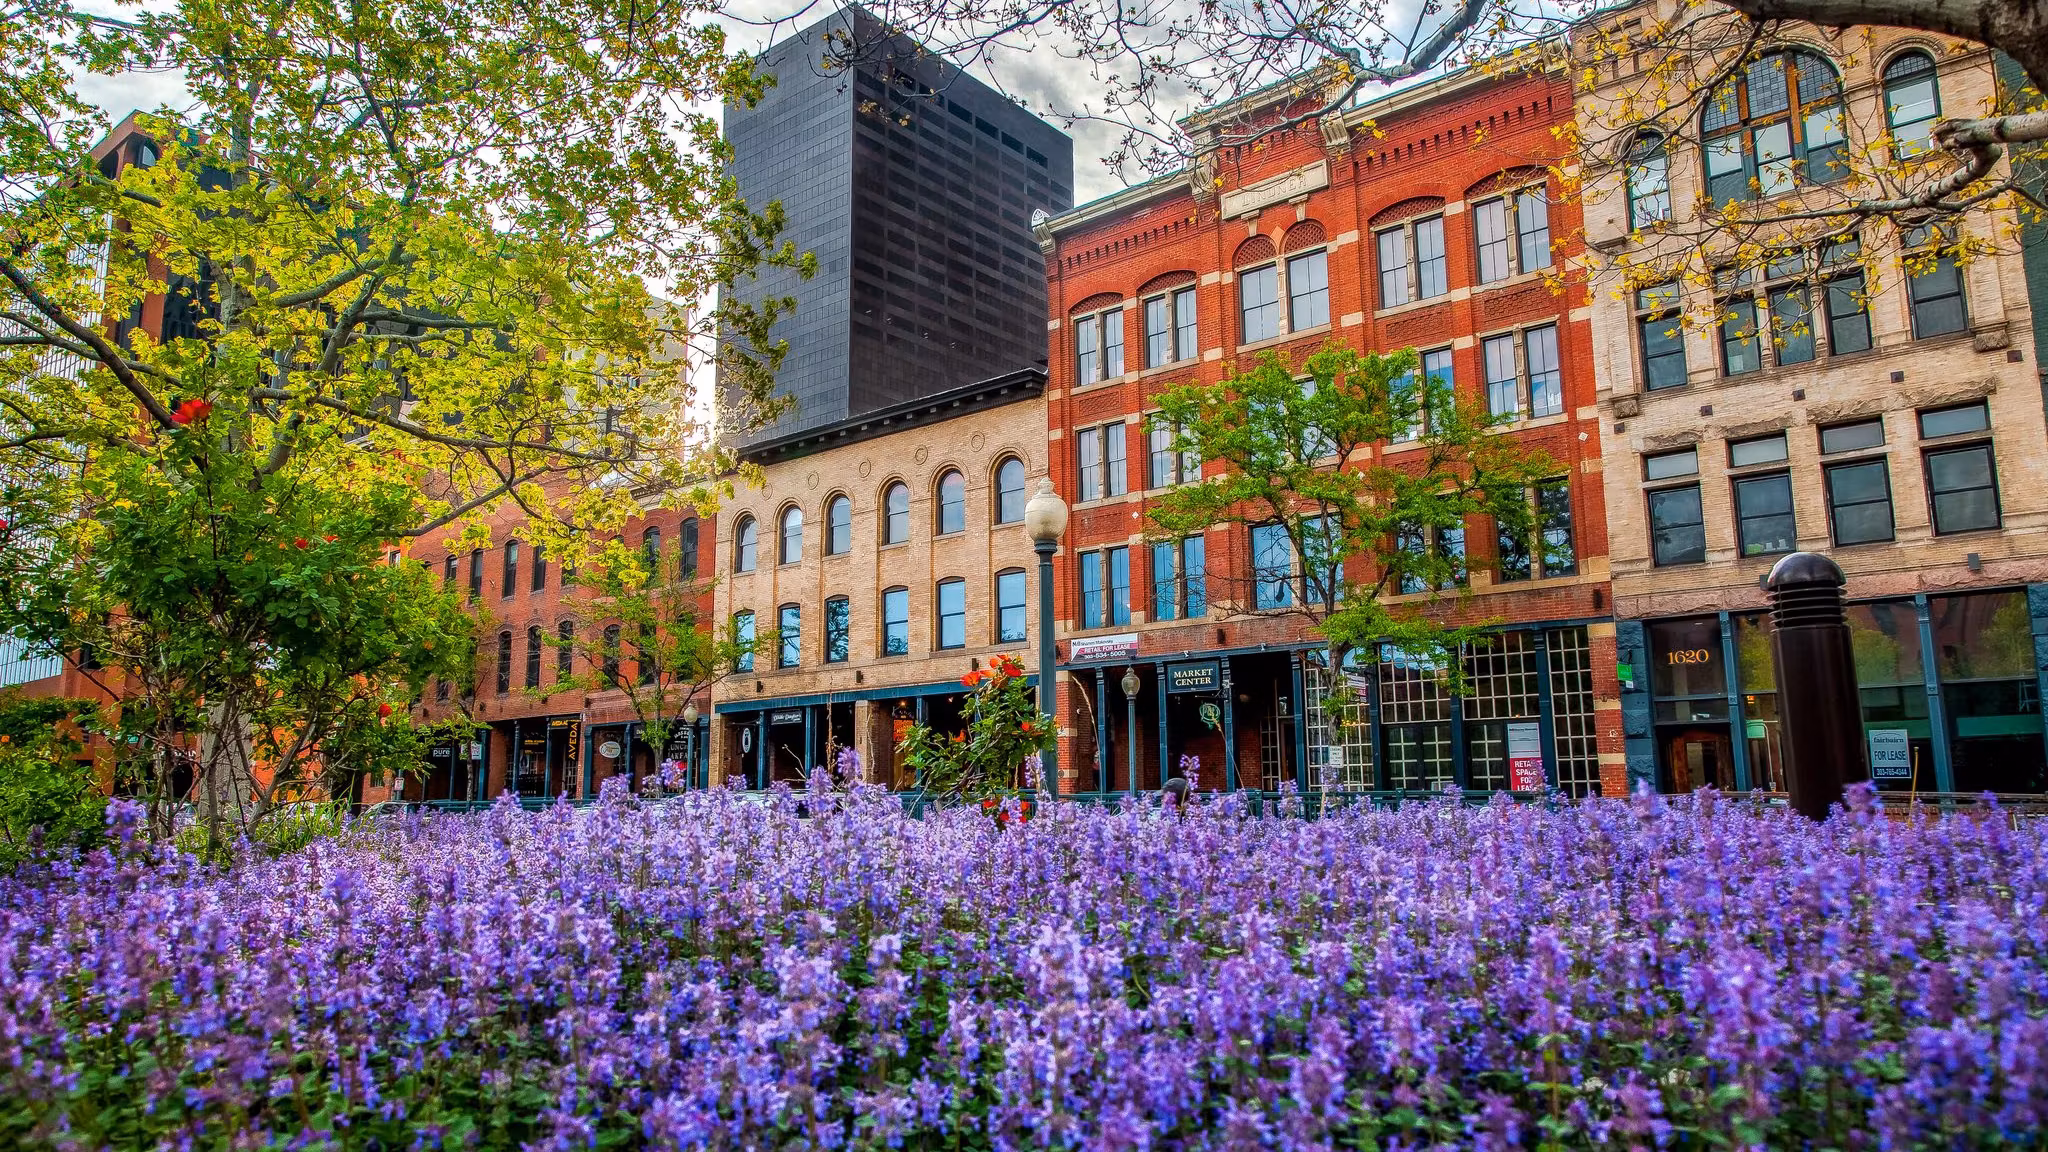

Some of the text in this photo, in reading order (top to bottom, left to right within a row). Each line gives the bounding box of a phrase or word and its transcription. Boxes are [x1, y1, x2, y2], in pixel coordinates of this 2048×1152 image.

[1667, 649, 1709, 665] 1620
[1174, 668, 1213, 678] MARKET
[1175, 677, 1212, 686] CENTER
[568, 722, 578, 760] AVEDA
[433, 749, 450, 757] pure
[1874, 750, 1906, 760] FOR LEASE
